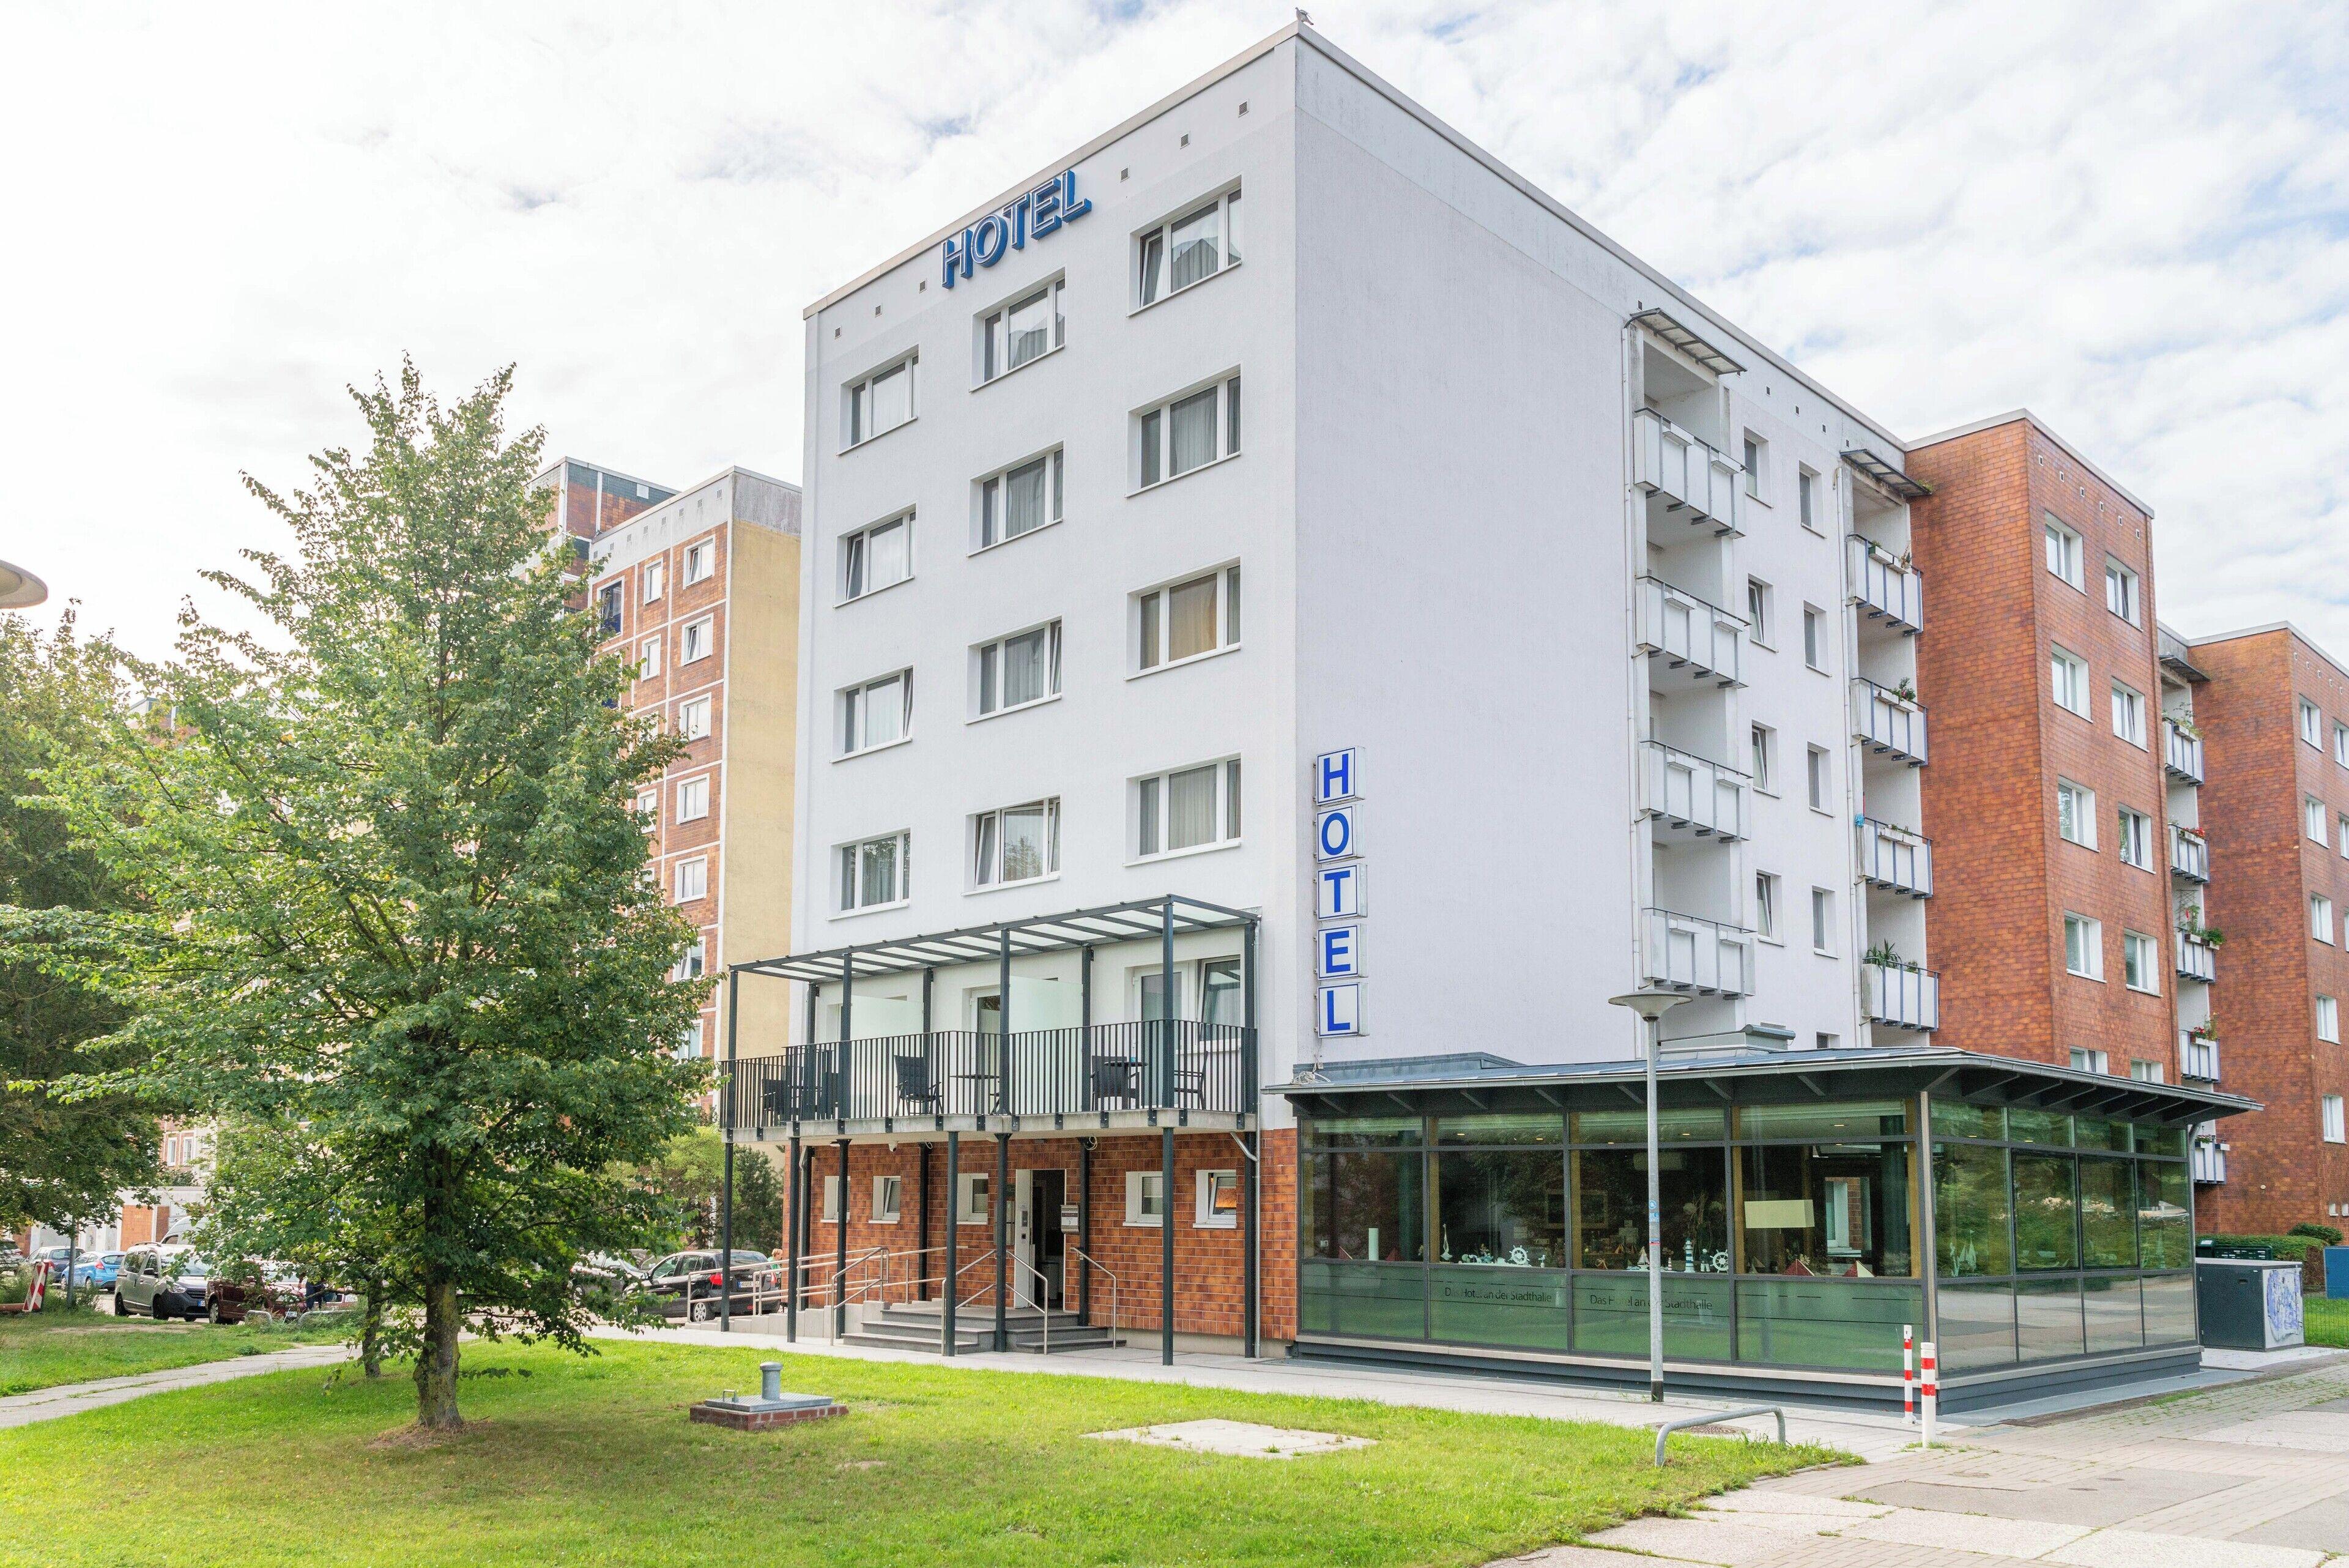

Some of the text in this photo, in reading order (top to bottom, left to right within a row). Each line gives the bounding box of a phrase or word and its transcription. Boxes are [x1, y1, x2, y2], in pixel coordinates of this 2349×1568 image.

[941, 169, 1092, 289] HOTEL
[1321, 753, 1351, 1031] HOTEL
[1589, 1294, 1607, 1305] Das
[1635, 1298, 1646, 1307] an
